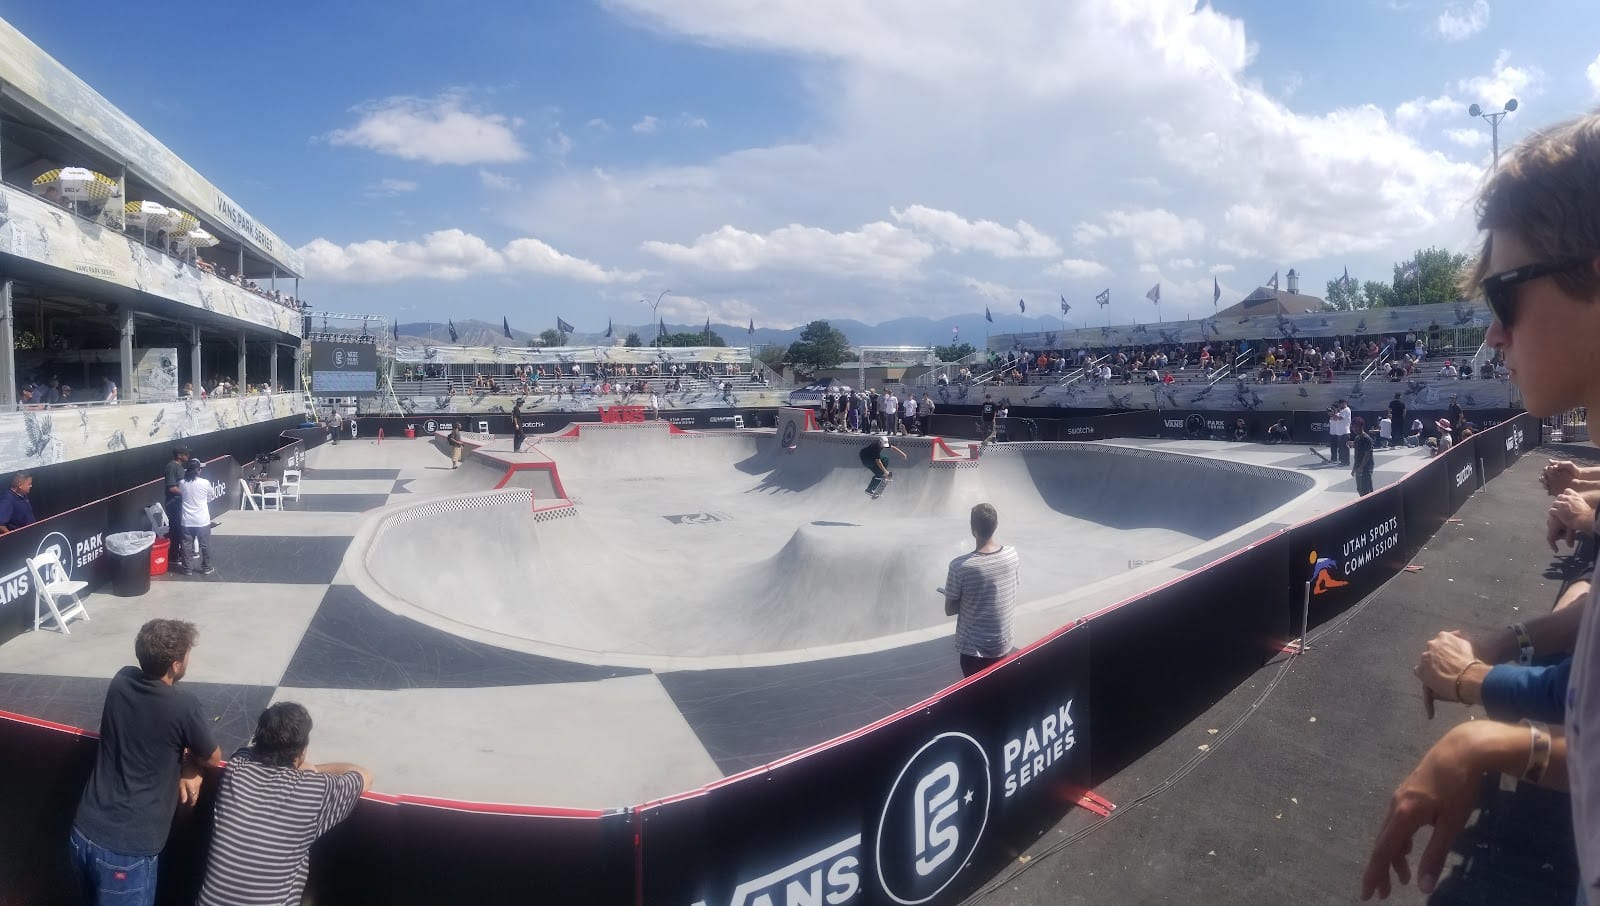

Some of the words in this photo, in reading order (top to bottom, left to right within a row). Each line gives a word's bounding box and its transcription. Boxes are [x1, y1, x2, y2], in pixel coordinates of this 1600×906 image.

[217, 195, 237, 223] VANS
[237, 212, 255, 238] PARK
[254, 227, 273, 252] SERIES
[597, 405, 646, 424] VANS
[1067, 426, 1090, 435] swatch
[1164, 419, 1184, 428] VANS
[209, 479, 226, 499] dobe
[76, 532, 103, 556] PARK
[1343, 533, 1367, 557] UTAH
[1369, 516, 1397, 542] SPORTS
[1344, 533, 1398, 576] COMMISSION
[77, 547, 104, 568] SERIES
[0, 566, 29, 605] ANS
[1003, 699, 1074, 774] PARK
[1004, 729, 1076, 798] SERIES
[690, 832, 862, 906] NS
